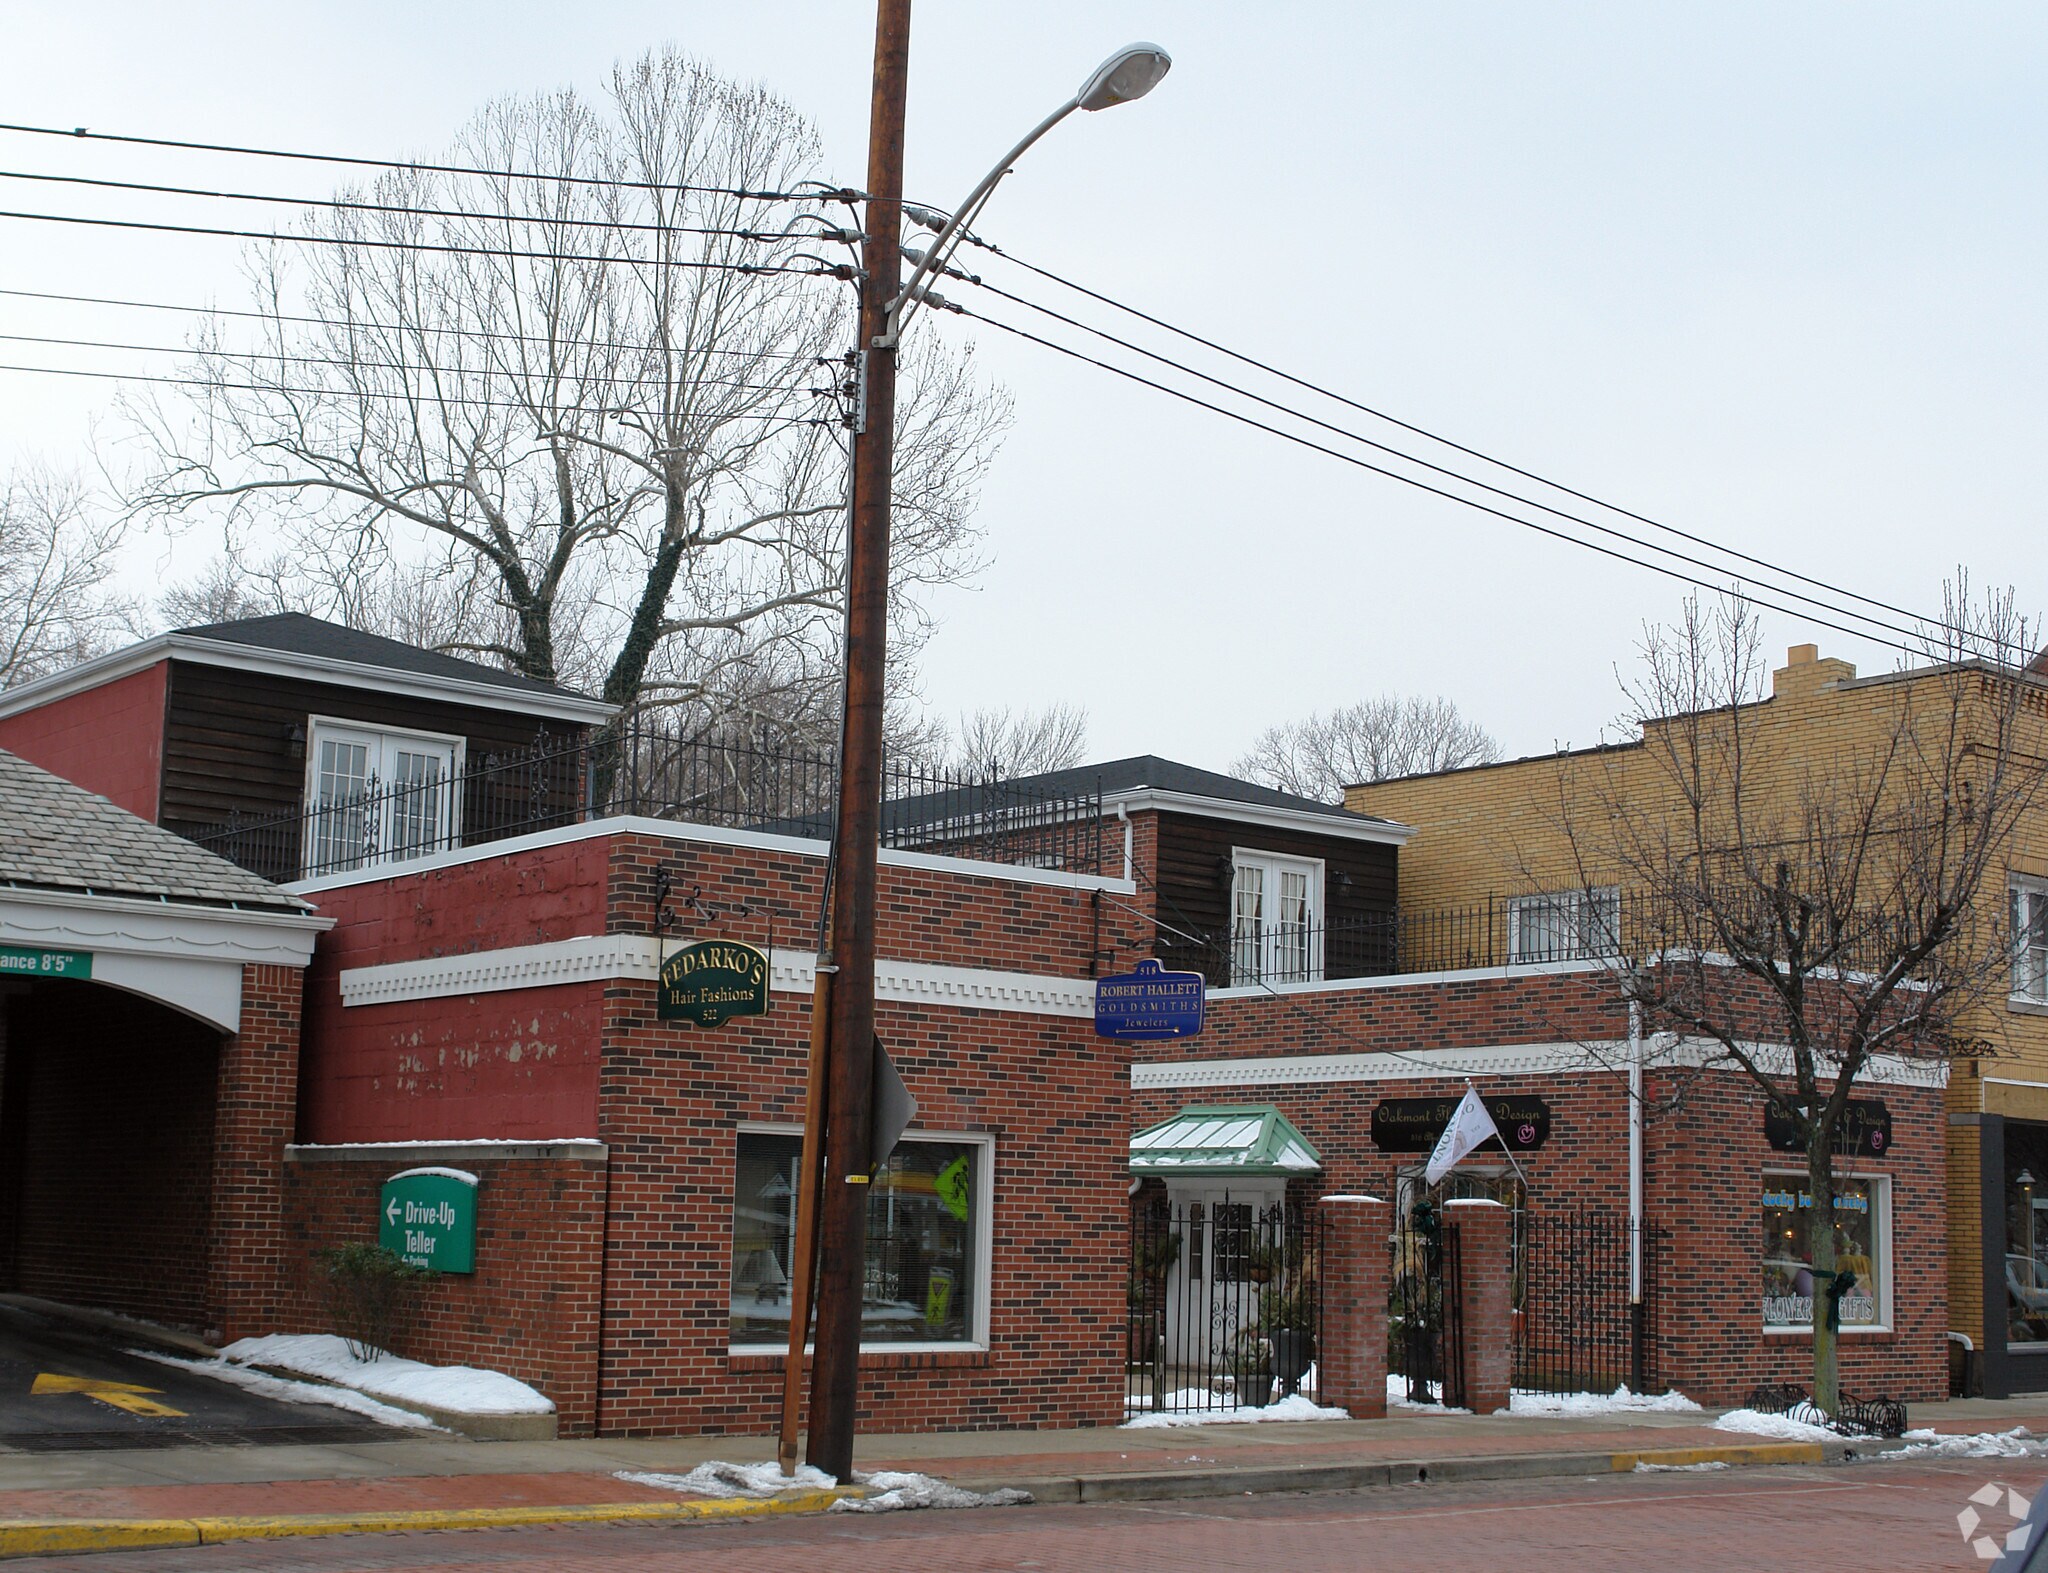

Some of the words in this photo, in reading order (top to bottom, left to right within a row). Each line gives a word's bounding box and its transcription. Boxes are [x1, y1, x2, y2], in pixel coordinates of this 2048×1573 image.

[0, 955, 36, 970] ance
[661, 947, 763, 990] FEDARKO'S
[671, 989, 696, 1005] Hair
[701, 987, 755, 1003] Fashions
[1100, 985, 1144, 998] ROBERT
[1147, 983, 1199, 996] HALLETT
[703, 1009, 718, 1021] 522
[1098, 1001, 1198, 1013] GOLDSMITHS
[1125, 1018, 1168, 1027] Jewelers
[1378, 1106, 1430, 1123] Oakmont
[1496, 1102, 1541, 1125] Design
[405, 1201, 455, 1231] Drive-Up
[405, 1230, 436, 1254] Teller
[1762, 1291, 1814, 1322] FLOWER
[1838, 1296, 1874, 1320] GIFTS
